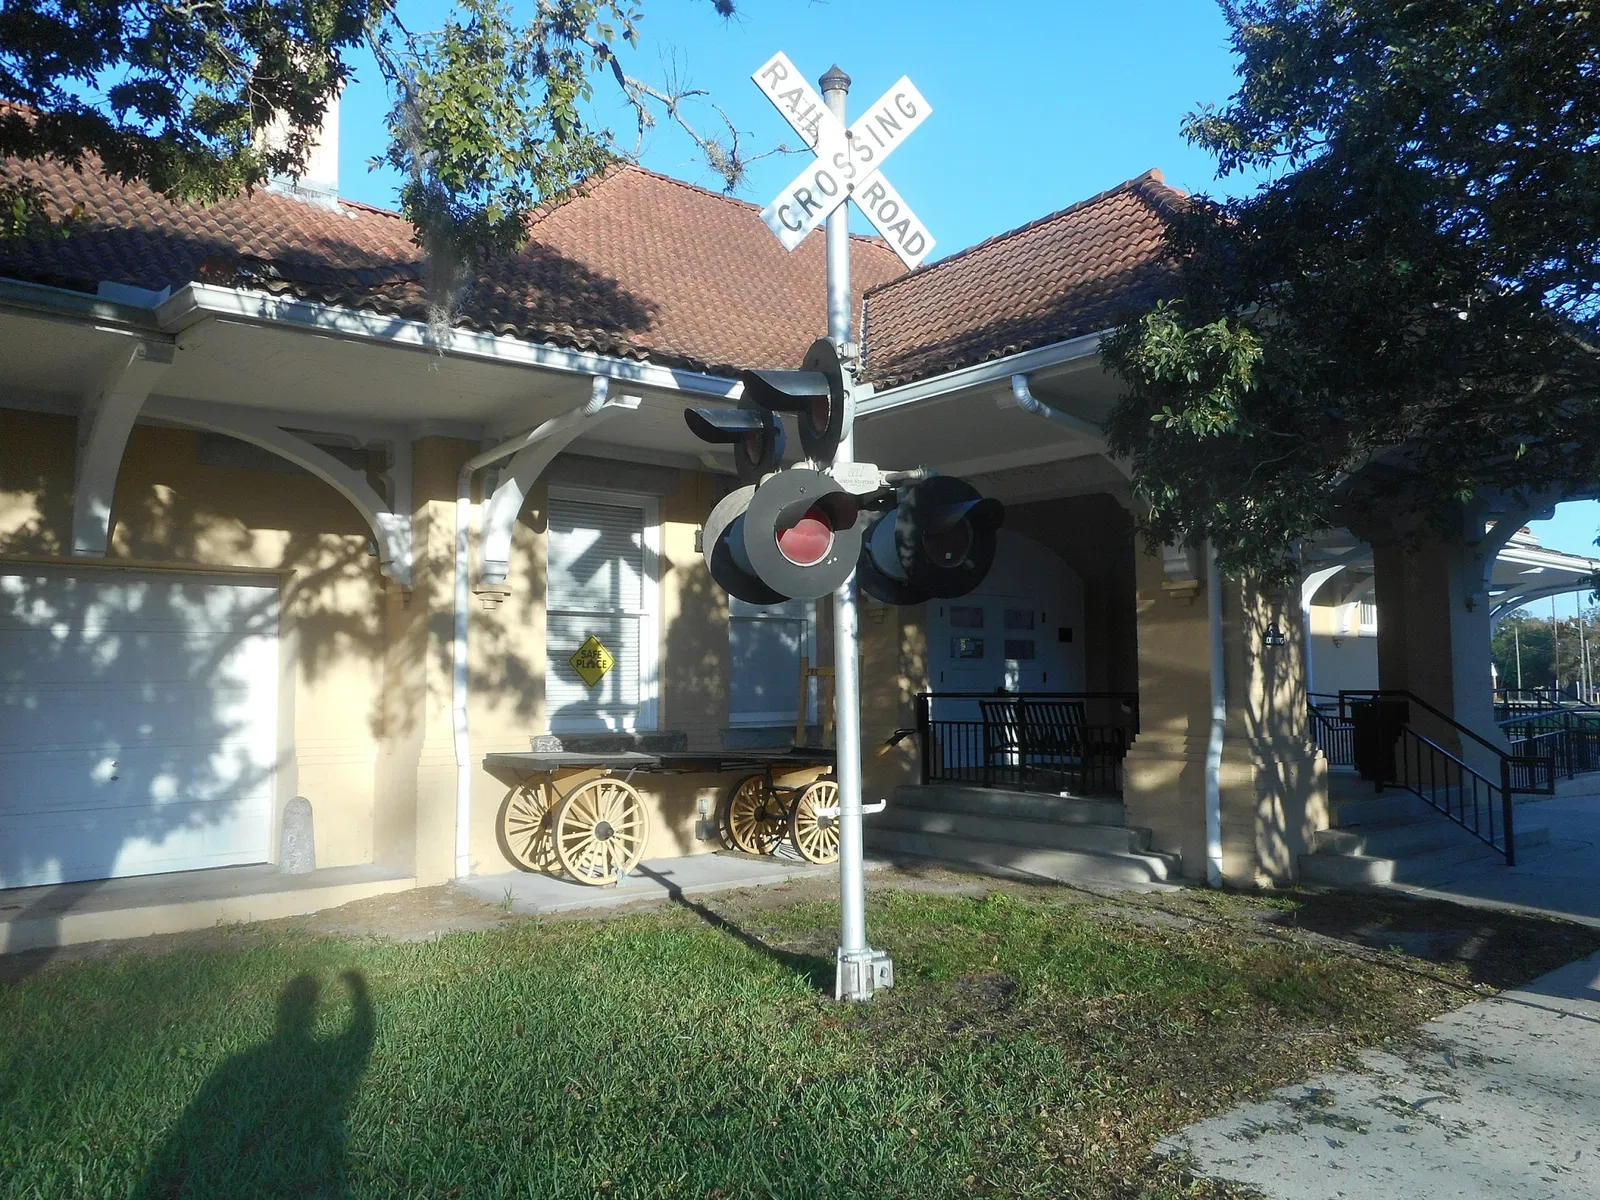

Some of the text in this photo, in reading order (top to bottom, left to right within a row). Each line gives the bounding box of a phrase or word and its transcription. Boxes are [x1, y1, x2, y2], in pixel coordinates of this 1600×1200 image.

[761, 60, 925, 257] RAIL ROAD
[777, 93, 917, 232] CROSSING
[576, 659, 607, 669] PLACE
[581, 650, 602, 659] SAFE
